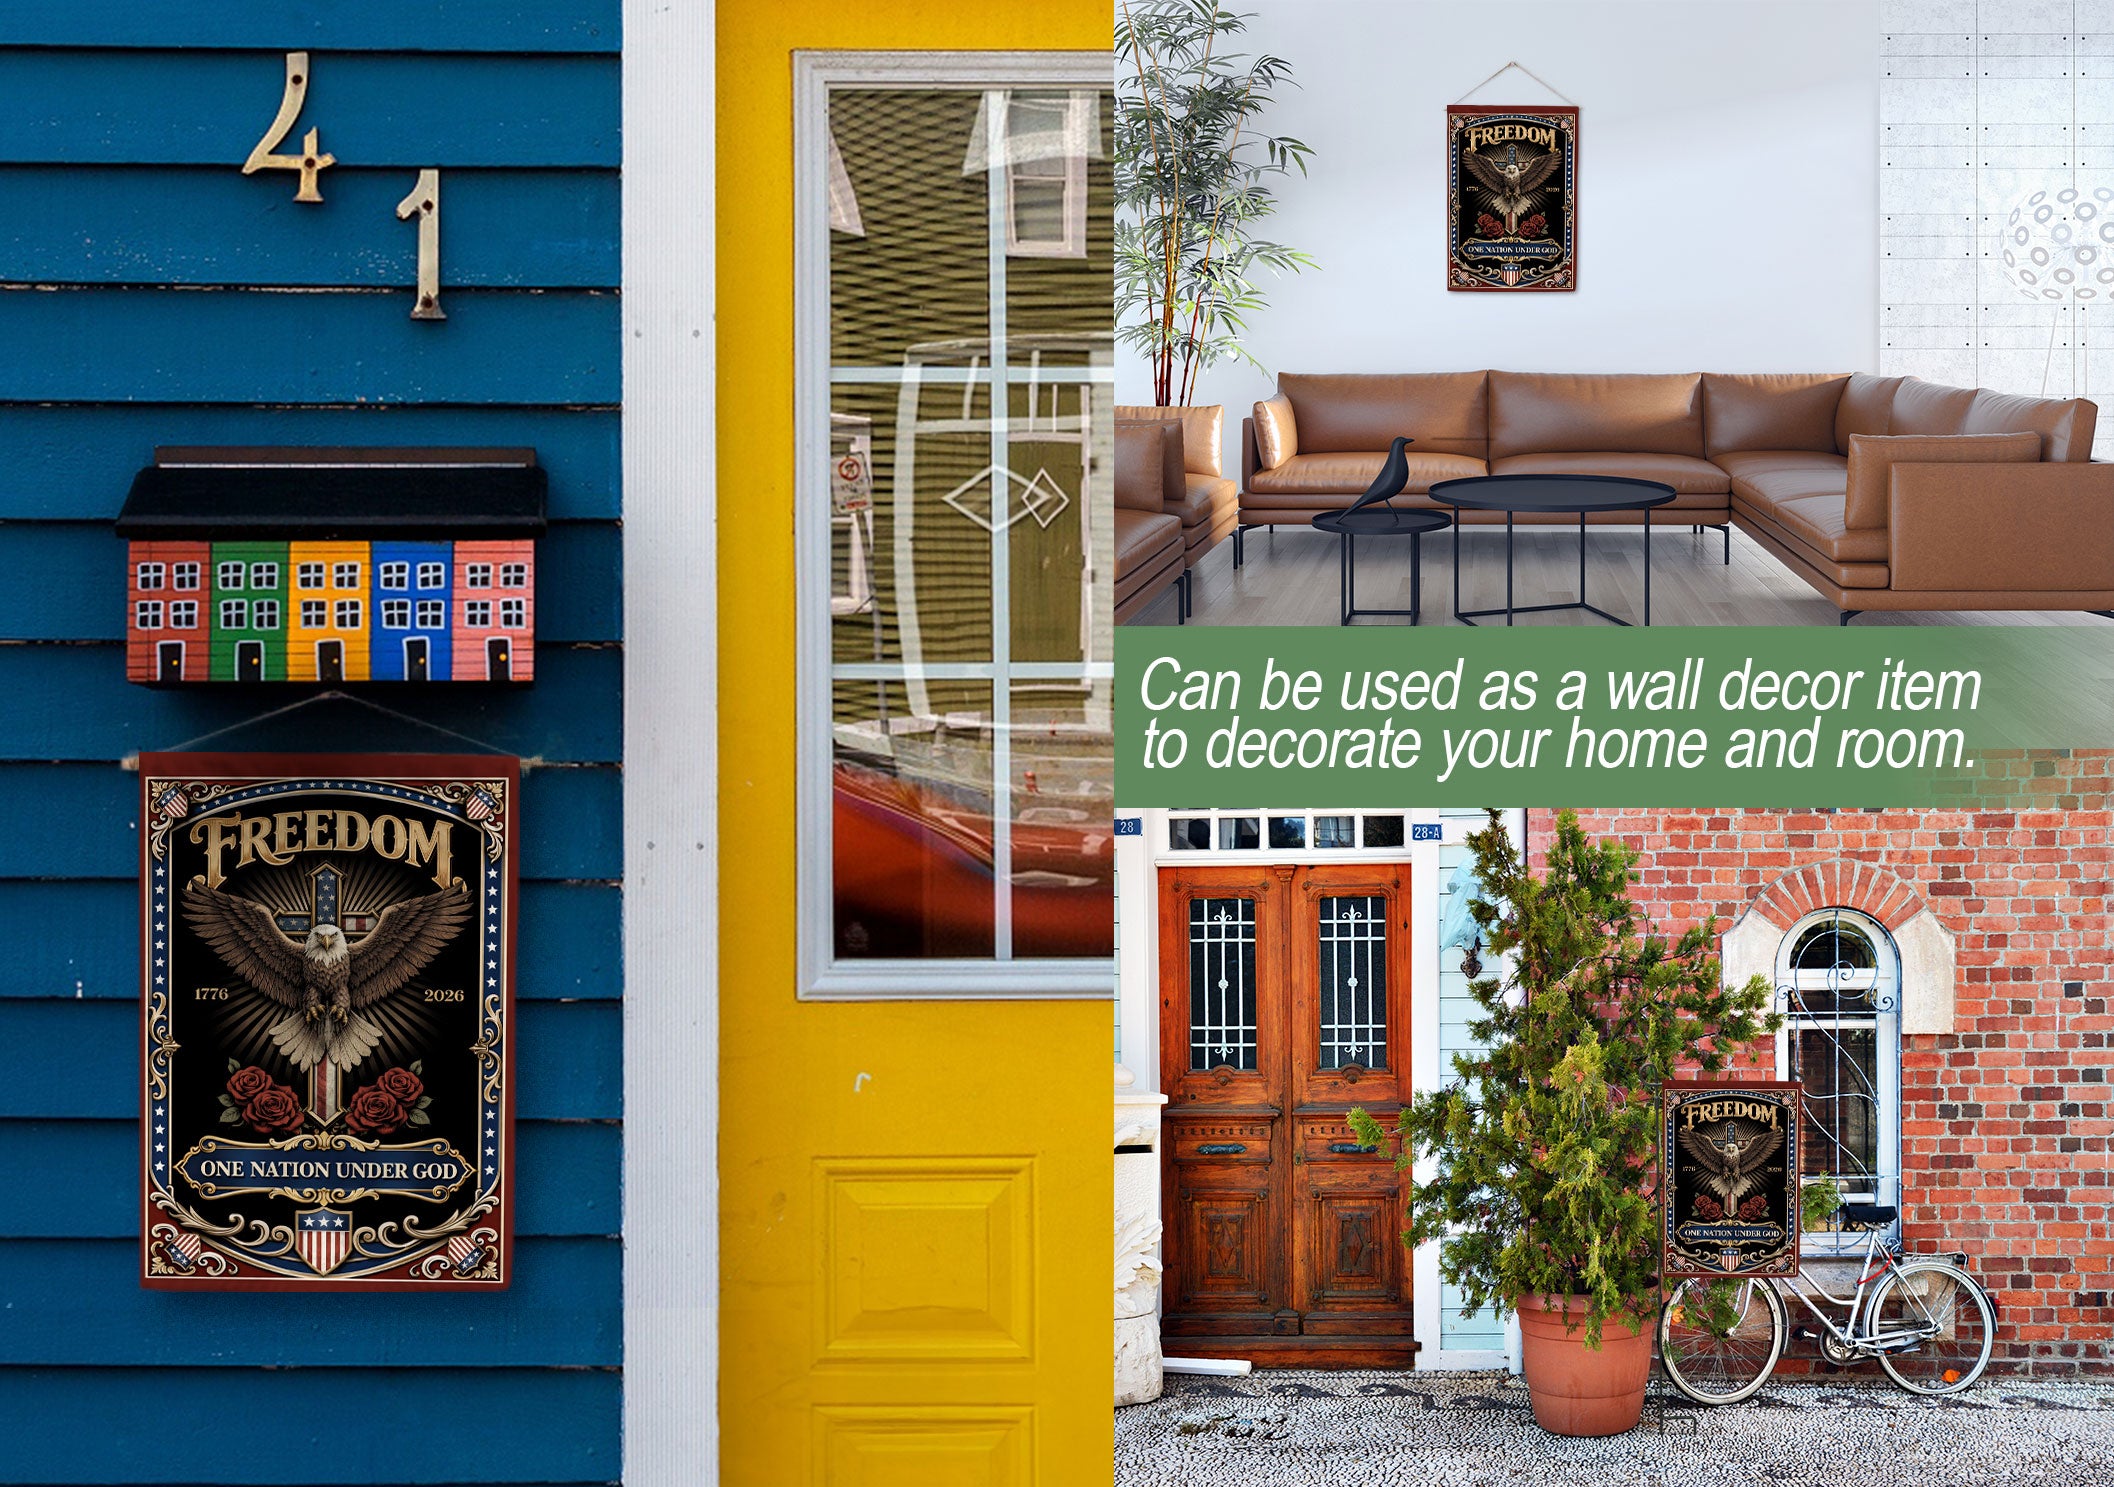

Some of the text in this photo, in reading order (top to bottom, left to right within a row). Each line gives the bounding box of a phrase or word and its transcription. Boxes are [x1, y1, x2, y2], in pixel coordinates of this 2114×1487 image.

[1464, 124, 1562, 153] FREEDOM
[1485, 246, 1514, 254] NATION
[1120, 821, 1134, 834] 28
[1414, 826, 1440, 839] 28-A
[189, 810, 462, 890] FREEDOM
[194, 987, 229, 1001] 1776
[424, 988, 464, 1002] 2026
[1680, 1100, 1783, 1132] FREEDOM
[200, 1160, 458, 1180] ONE NATION UNDER GOD
[1684, 1229, 1702, 1237] ONE
[1734, 1230, 1761, 1238] UNDER
